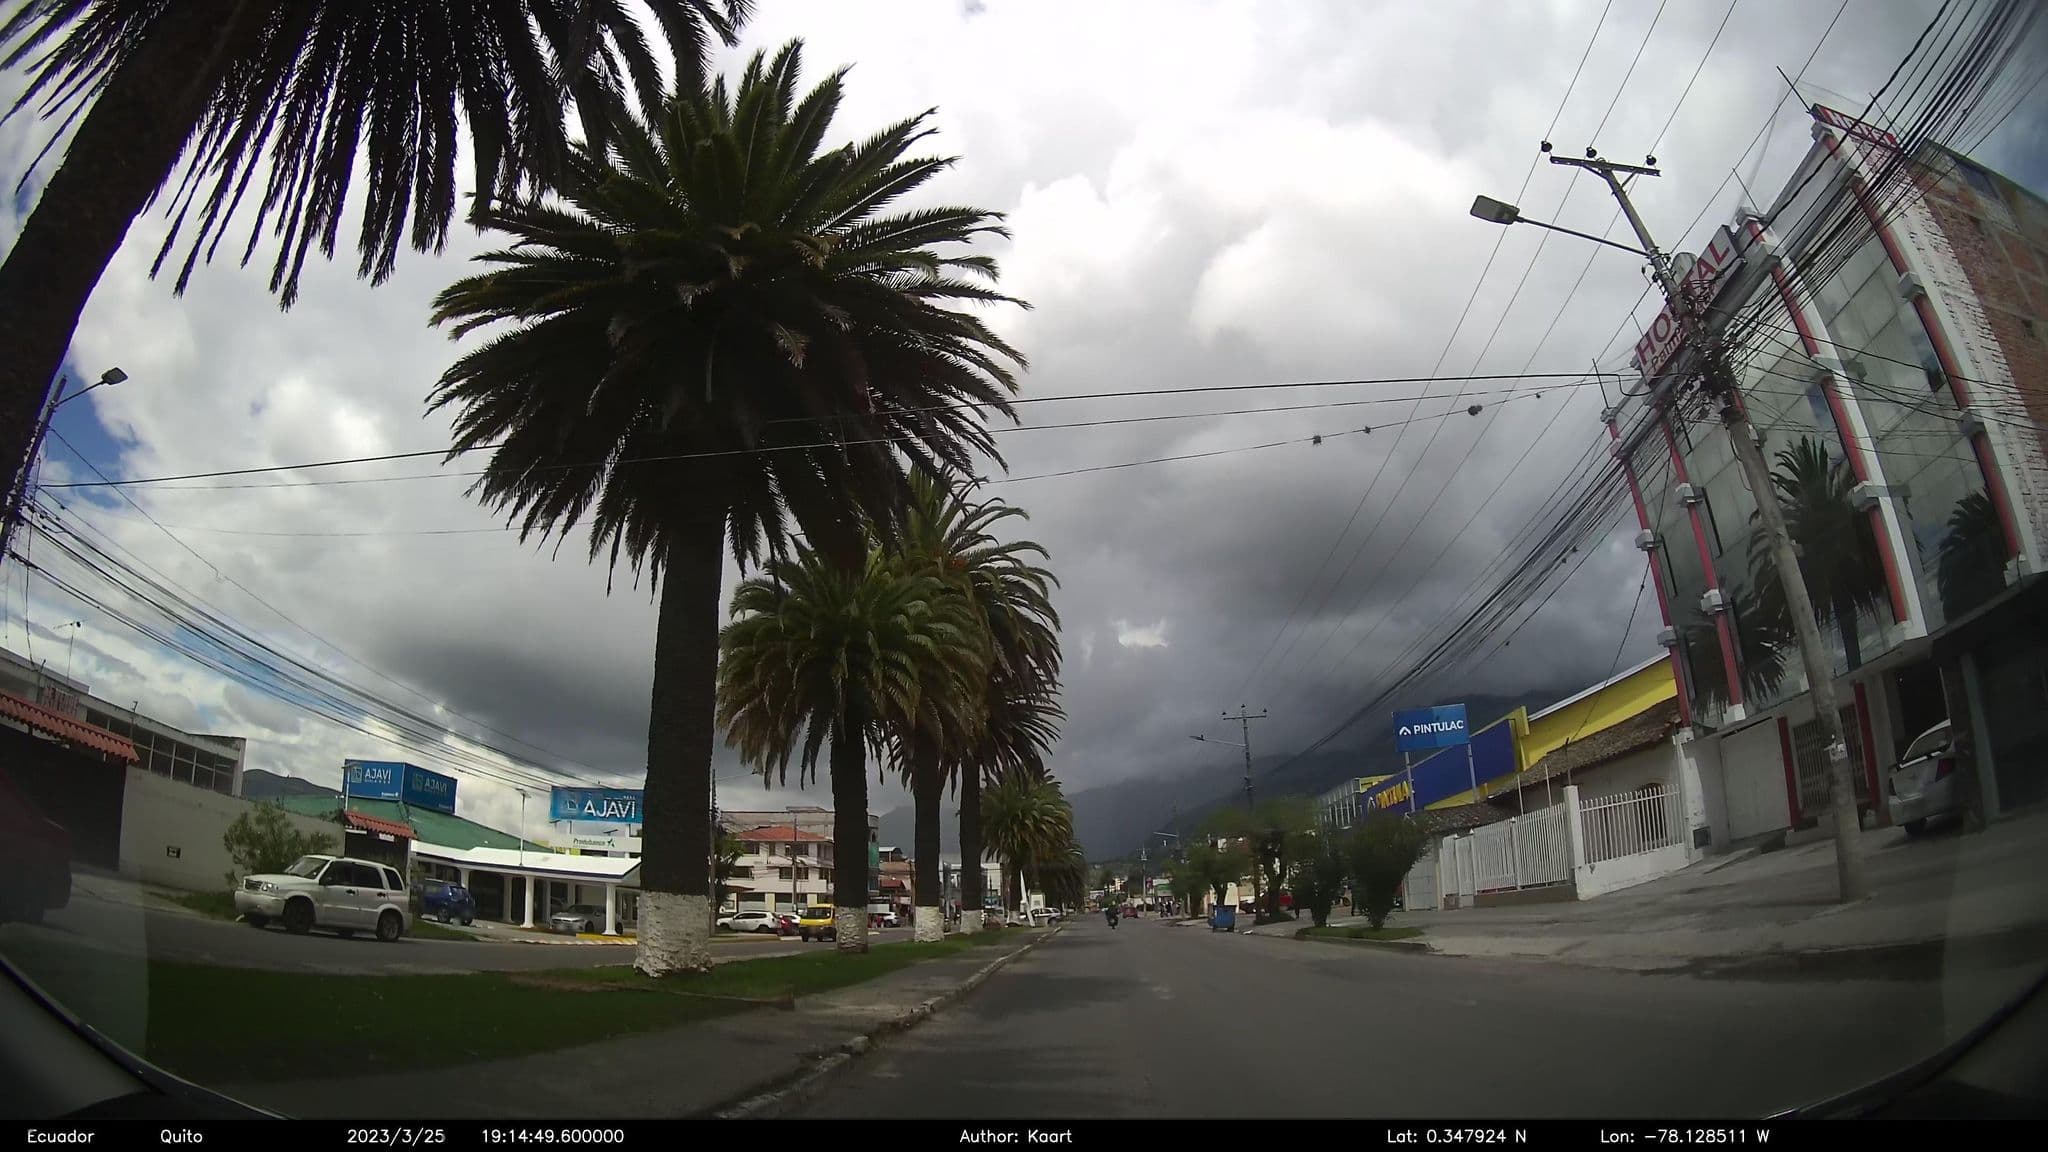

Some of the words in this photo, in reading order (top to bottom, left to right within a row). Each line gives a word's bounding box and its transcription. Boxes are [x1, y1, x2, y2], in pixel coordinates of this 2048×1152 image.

[1636, 242, 1730, 366] HOTAL
[1413, 719, 1464, 735] PINTULAC
[364, 767, 392, 781] AJAVI
[424, 778, 448, 793] AJAVI
[584, 799, 636, 819] AJAVI
